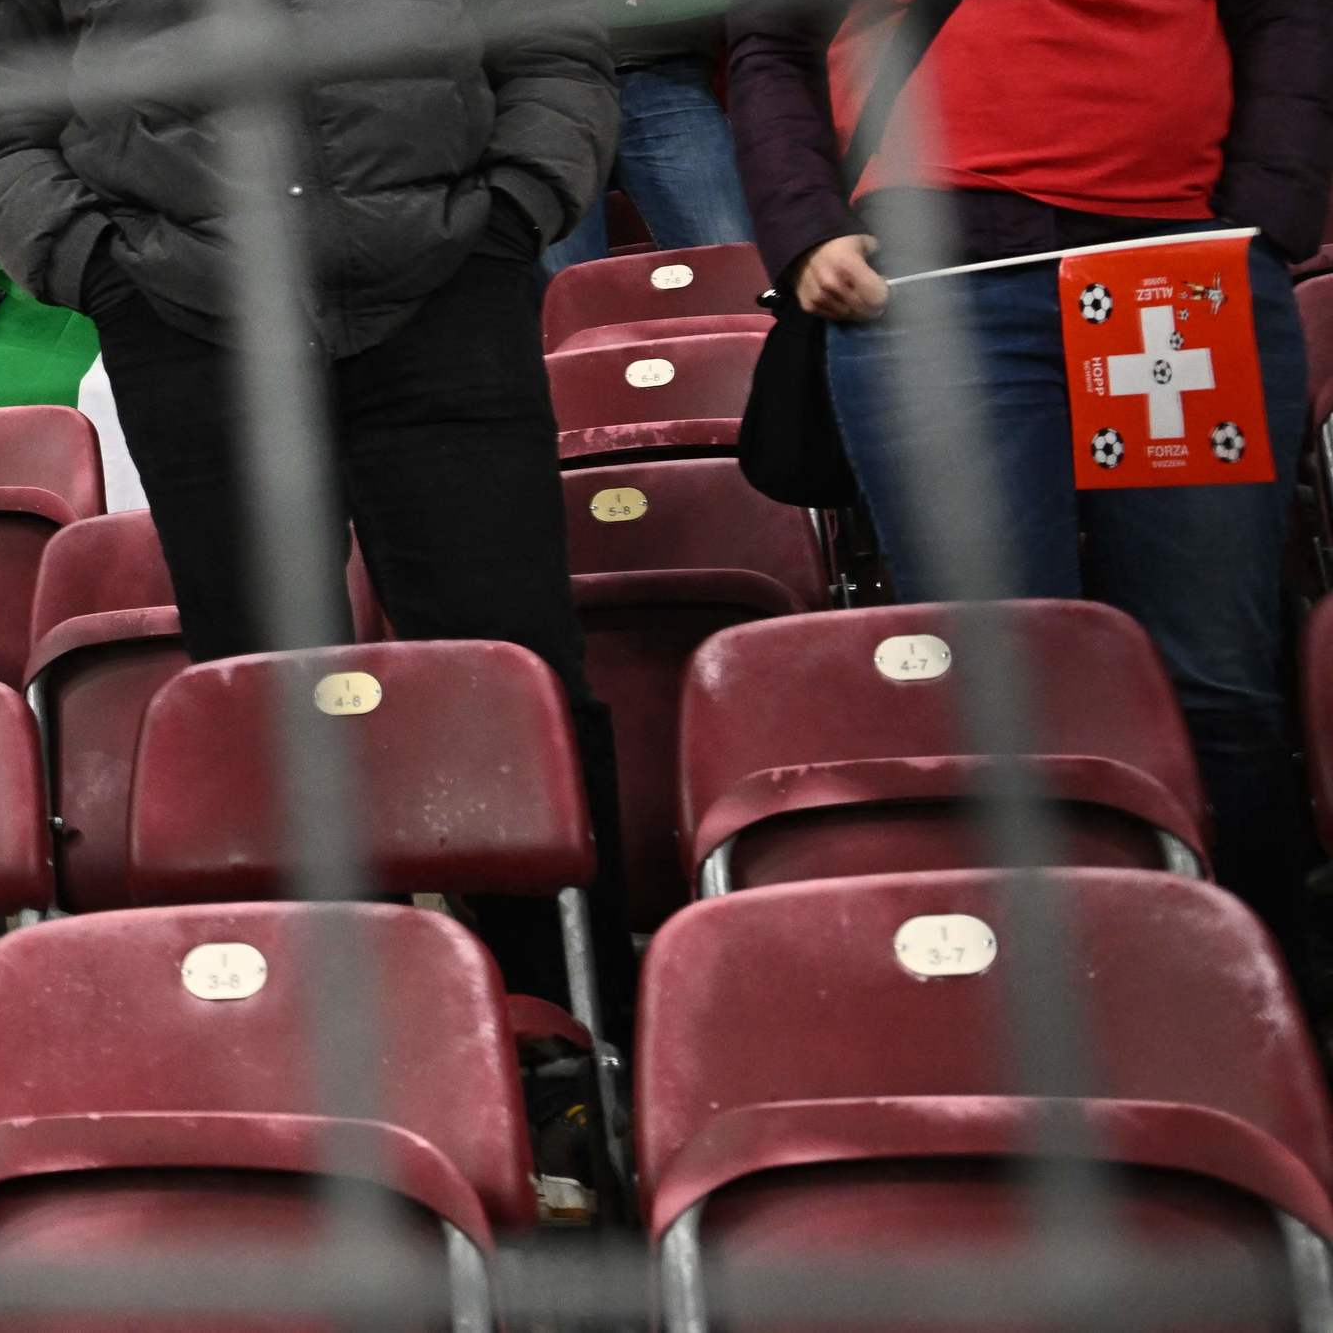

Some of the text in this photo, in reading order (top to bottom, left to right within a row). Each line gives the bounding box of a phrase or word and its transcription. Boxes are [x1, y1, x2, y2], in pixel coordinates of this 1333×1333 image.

[1135, 286, 1173, 301] ALLEZ
[1091, 357, 1104, 396] HOPP
[1147, 445, 1189, 458] FORZA
[609, 506, 631, 516] 5-8
[901, 659, 928, 671] 4-7
[334, 696, 361, 707] 4-8
[929, 947, 965, 965] 3-7
[209, 974, 240, 989] 3-8
